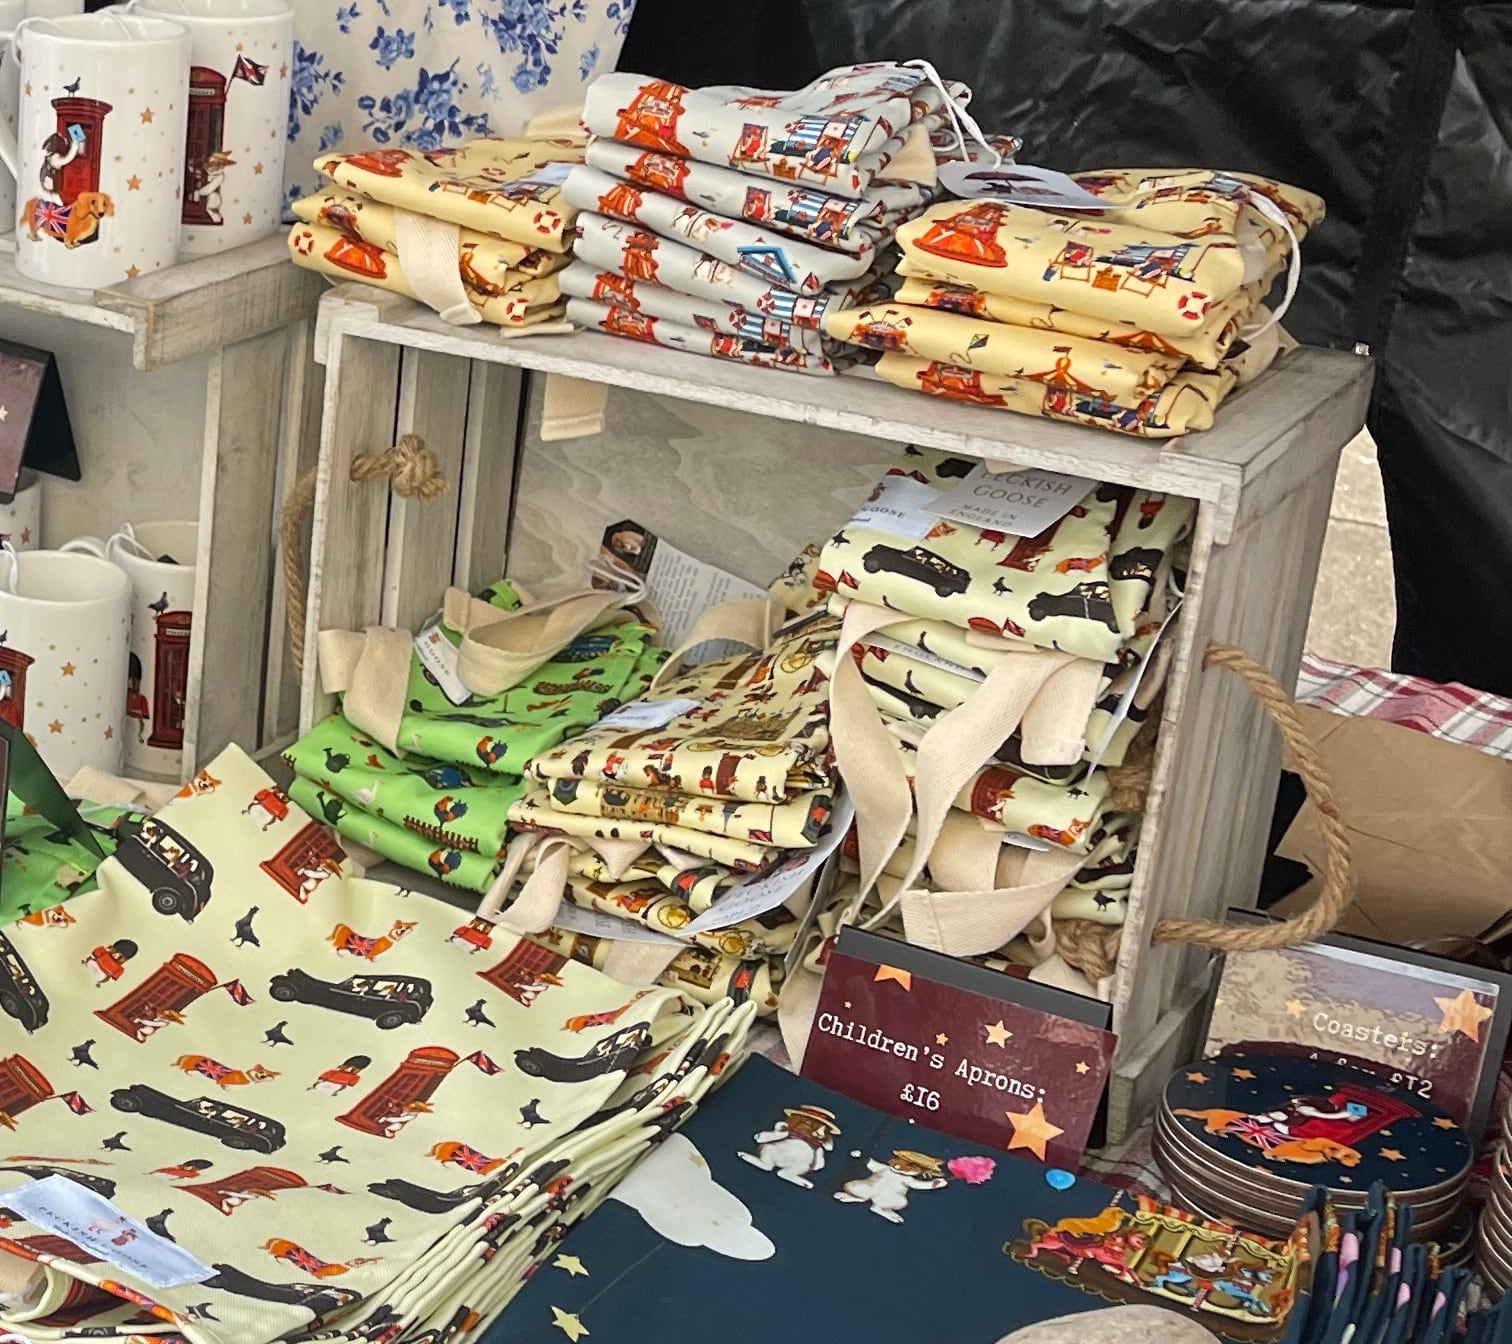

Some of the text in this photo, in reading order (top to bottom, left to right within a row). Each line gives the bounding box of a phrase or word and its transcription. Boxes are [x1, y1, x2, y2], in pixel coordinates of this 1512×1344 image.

[972, 484, 1050, 509] GOOSE
[948, 509, 1014, 528] ENGLAND
[963, 503, 1017, 521] MADE IN
[1313, 1012, 1438, 1059] Coasters:
[818, 1012, 1046, 1104] Children's Aprons:
[899, 1083, 941, 1111] £16
